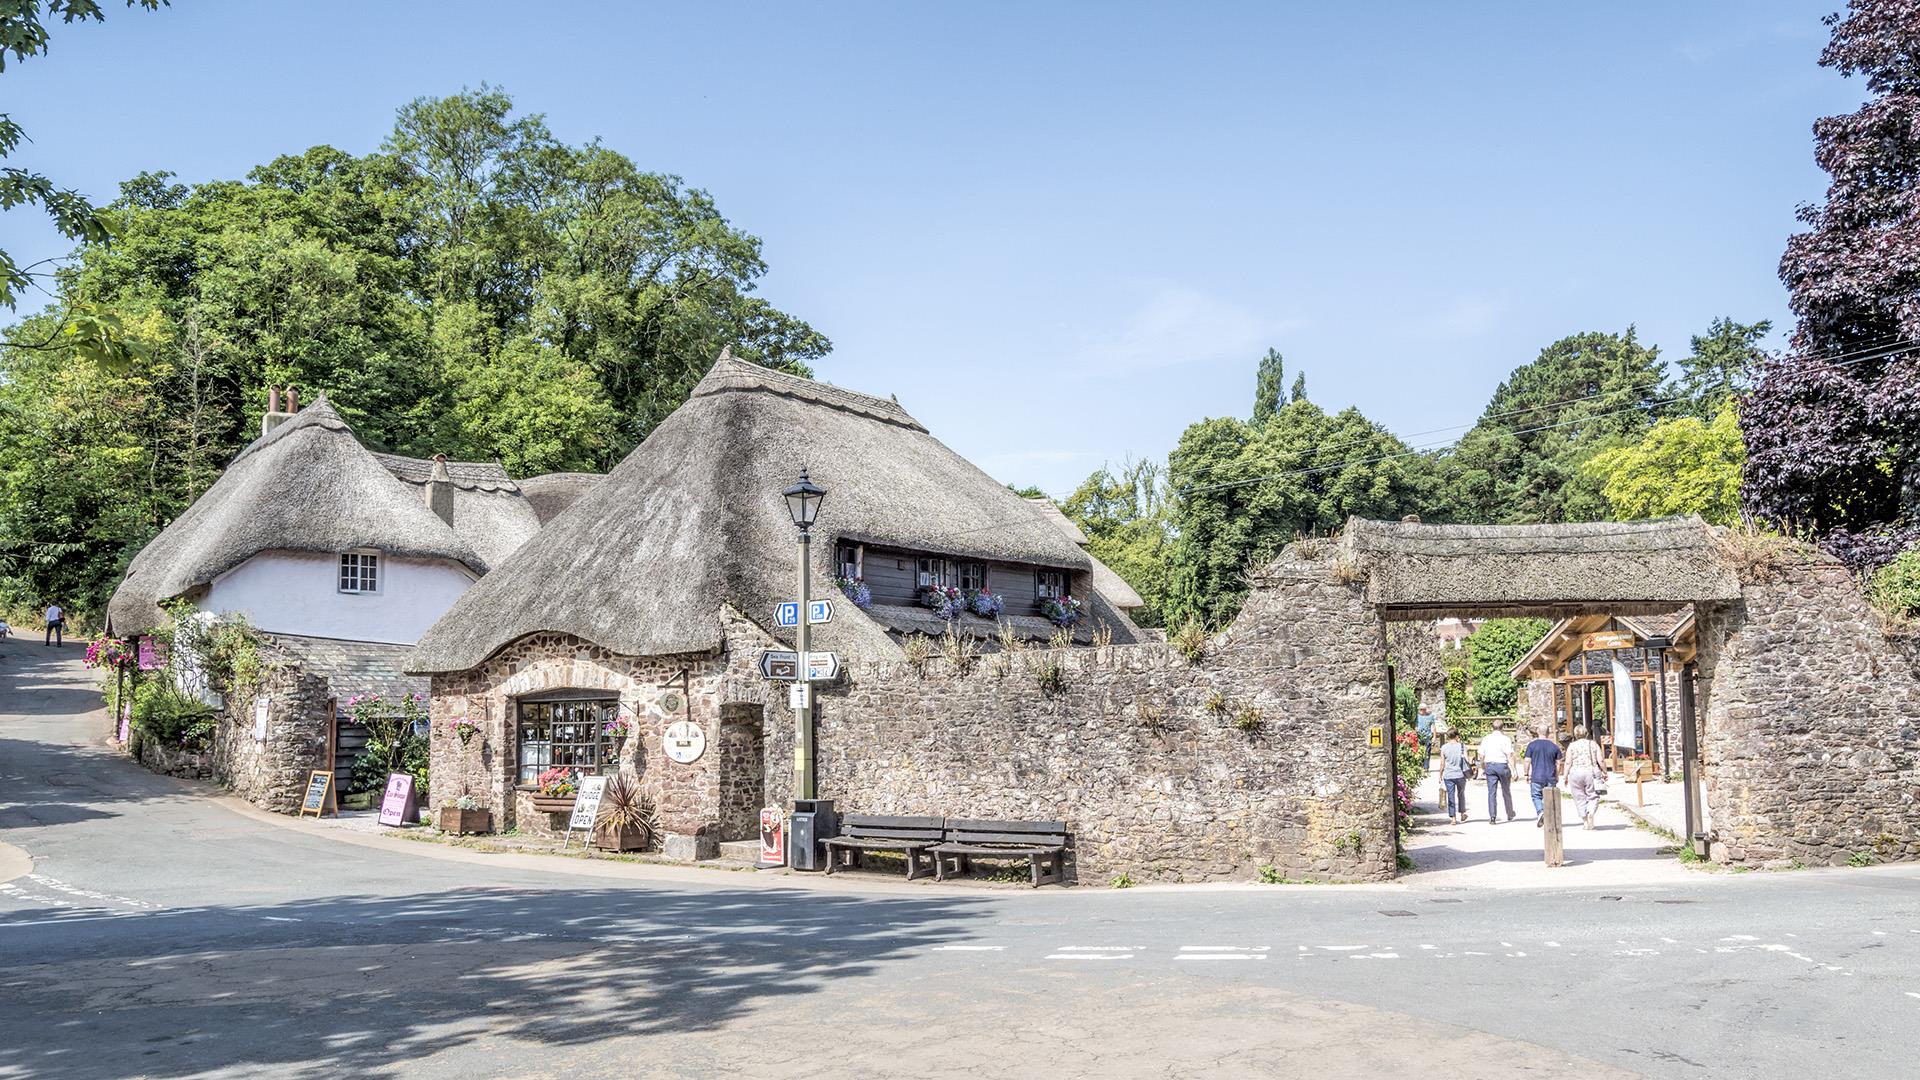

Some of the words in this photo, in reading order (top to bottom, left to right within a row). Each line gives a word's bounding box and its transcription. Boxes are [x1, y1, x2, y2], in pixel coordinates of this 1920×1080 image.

[785, 605, 794, 623] P
[812, 605, 820, 619] P
[1370, 729, 1381, 744] H
[582, 791, 600, 801] FUDGE
[382, 807, 401, 817] Open
[574, 814, 593, 826] OPEN
